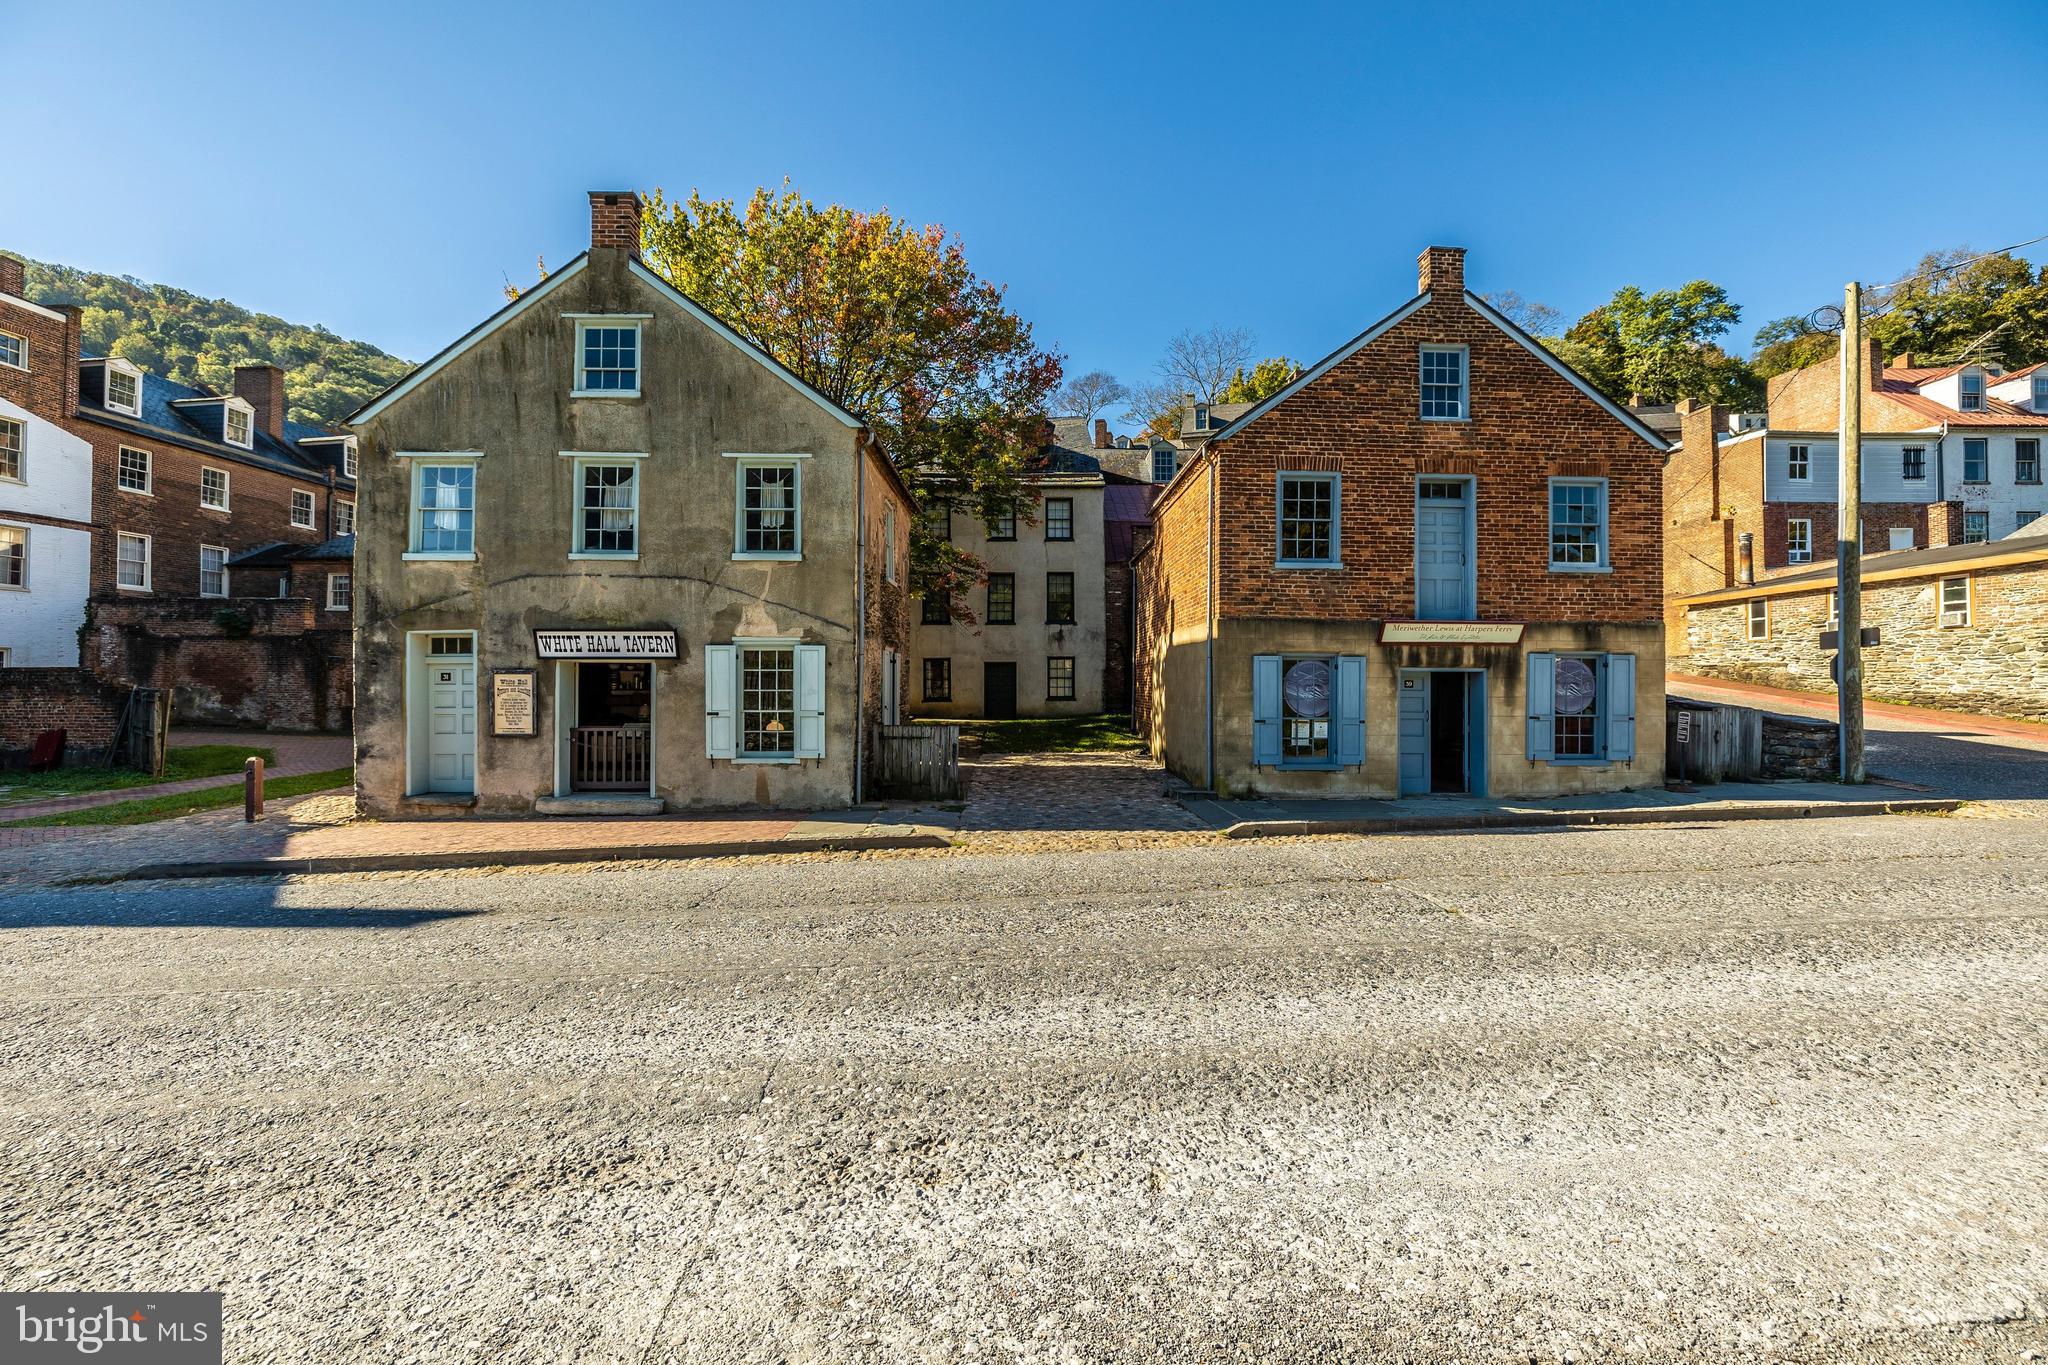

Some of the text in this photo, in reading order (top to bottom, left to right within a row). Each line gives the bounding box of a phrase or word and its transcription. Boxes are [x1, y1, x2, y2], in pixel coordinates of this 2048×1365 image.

[1392, 624, 1434, 632] Meriwether
[1435, 624, 1454, 632] Lewis
[1465, 624, 1493, 634] Harpers
[1494, 625, 1513, 633] Ferry
[538, 635, 674, 653] WHITE HALL TAVERN
